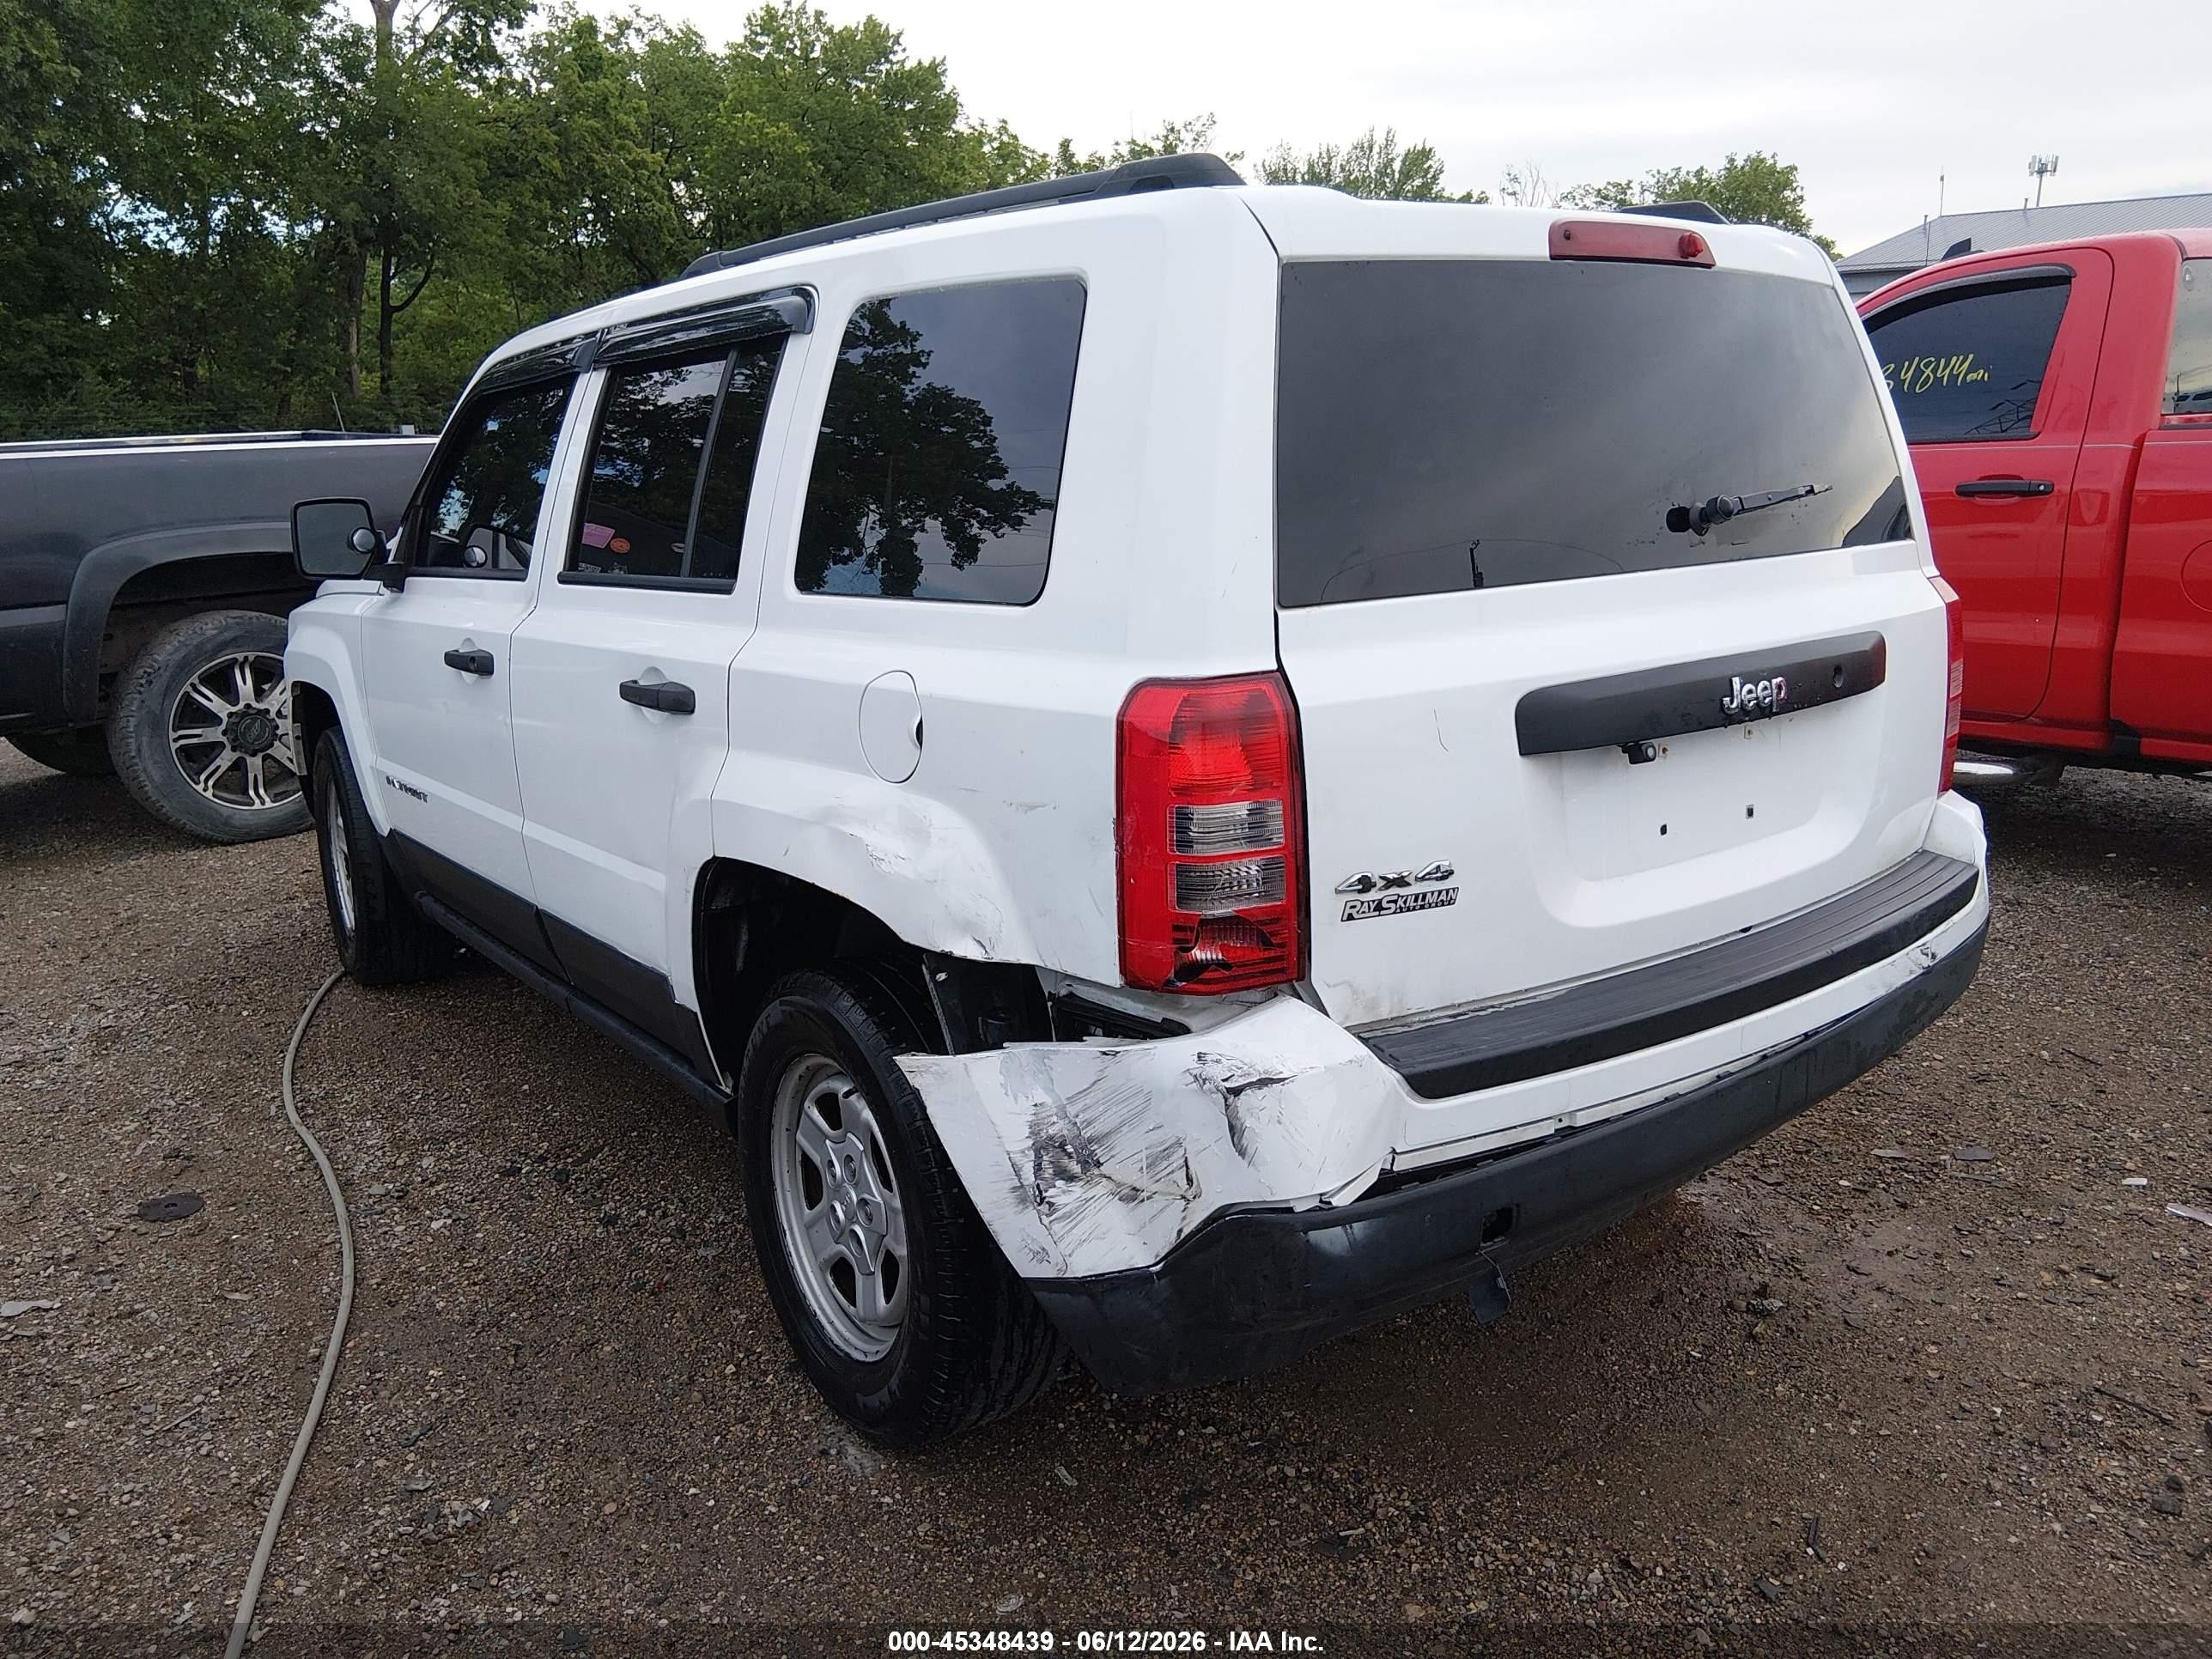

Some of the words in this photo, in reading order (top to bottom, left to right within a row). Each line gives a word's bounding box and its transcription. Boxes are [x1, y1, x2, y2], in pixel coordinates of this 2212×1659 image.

[1721, 676, 1788, 714] Jeep
[1395, 905, 1420, 914] AUTO
[1425, 899, 1455, 908] GROUP
